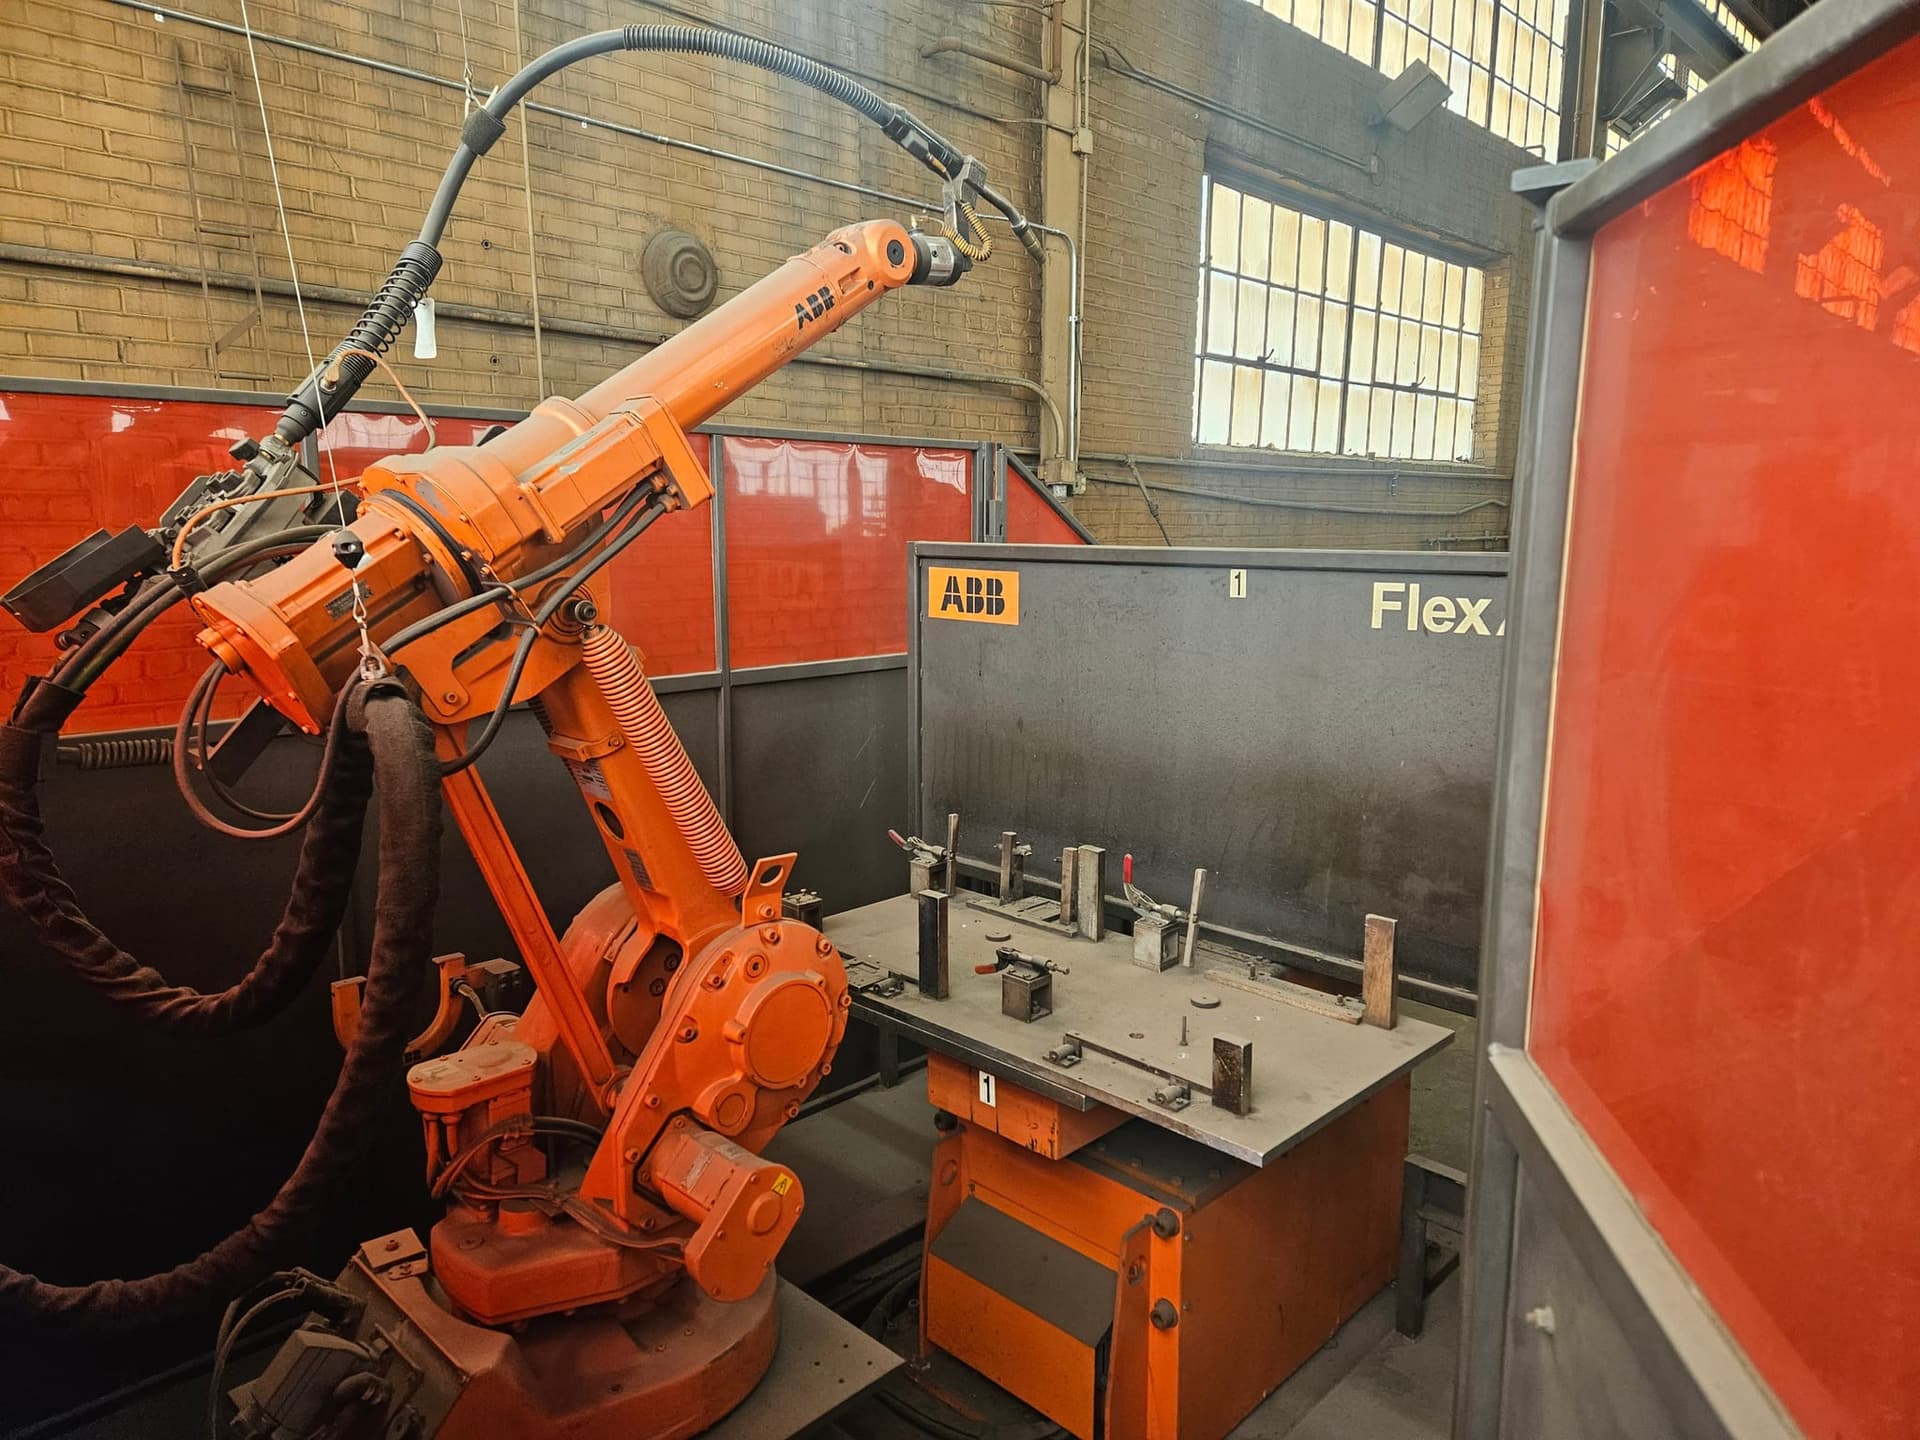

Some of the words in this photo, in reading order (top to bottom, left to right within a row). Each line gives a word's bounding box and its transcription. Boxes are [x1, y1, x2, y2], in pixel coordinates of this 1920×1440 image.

[795, 286, 834, 330] ABB
[941, 575, 1005, 615] ABB
[1234, 571, 1241, 596] 1
[1371, 582, 1505, 636] Flex
[983, 1075, 990, 1103] 1
